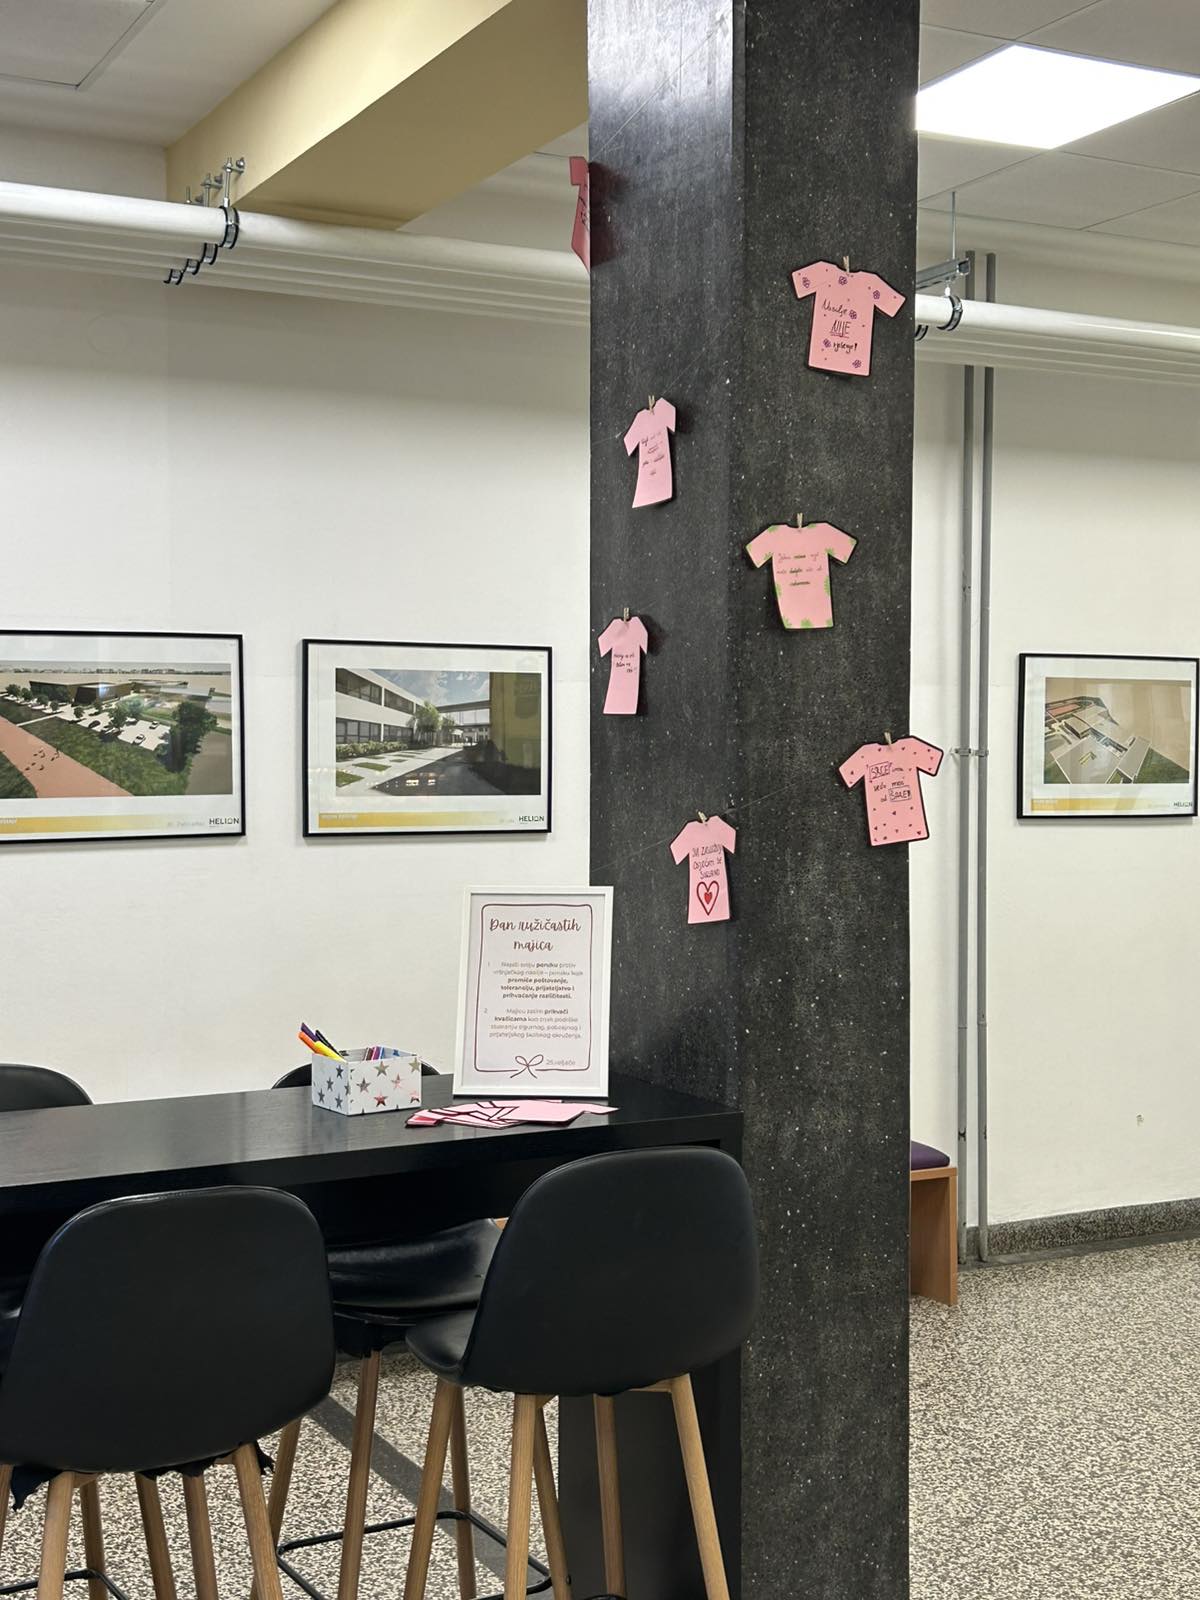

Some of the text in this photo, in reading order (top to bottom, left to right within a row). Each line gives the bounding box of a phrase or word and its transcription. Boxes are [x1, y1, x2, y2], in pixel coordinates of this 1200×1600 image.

[831, 320, 852, 337] NIJE
[208, 817, 240, 825] HELION
[489, 918, 581, 932] Dan ružičastih
[513, 940, 554, 952] majica
